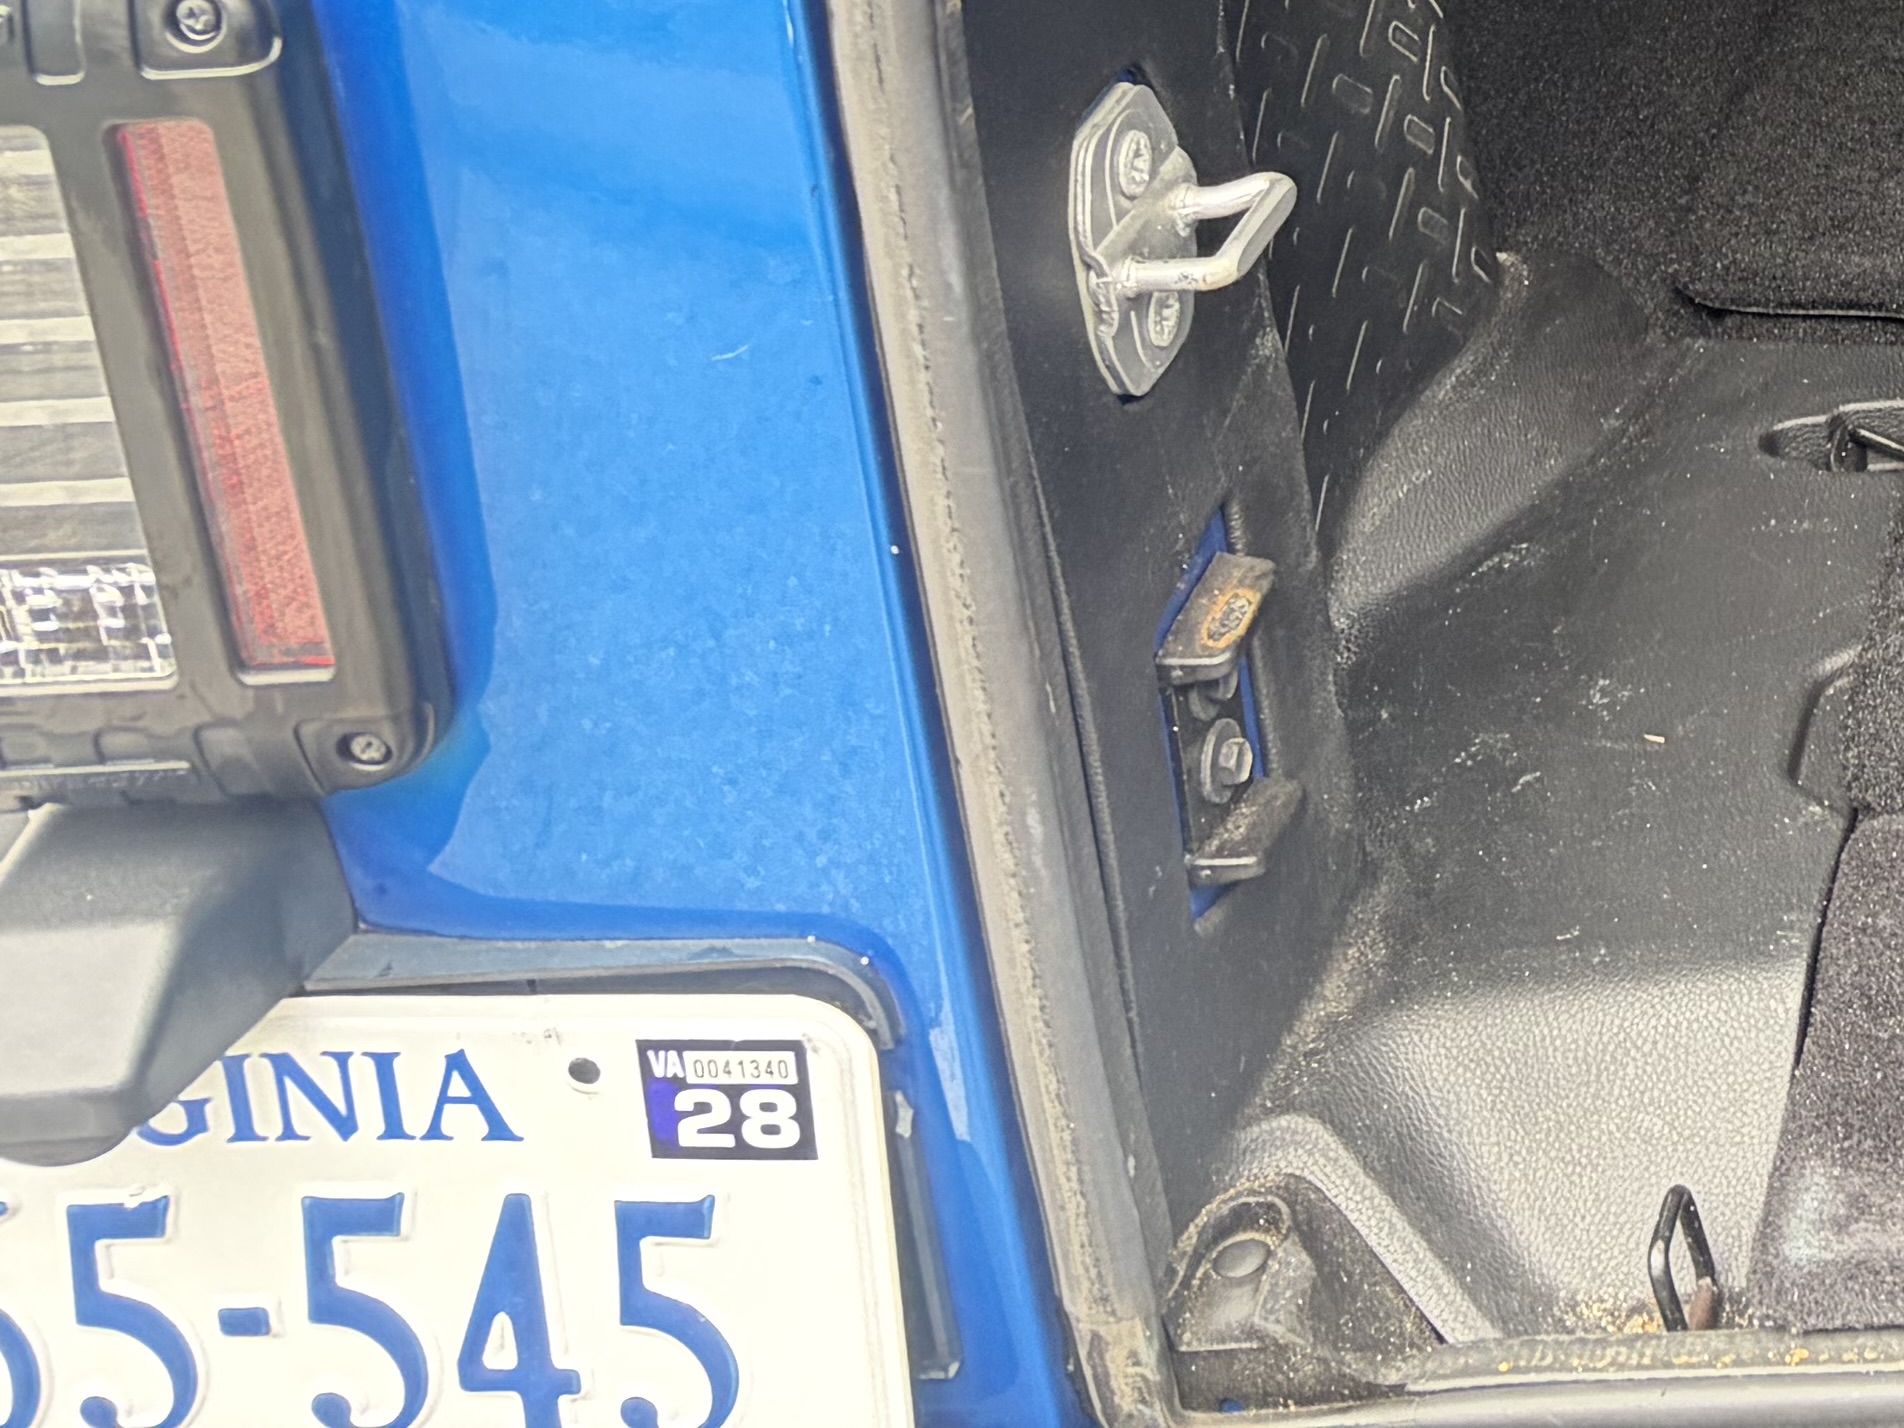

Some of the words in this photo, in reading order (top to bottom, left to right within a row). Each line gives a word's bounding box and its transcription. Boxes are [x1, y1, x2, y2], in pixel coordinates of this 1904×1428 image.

[646, 1049, 686, 1079] VA
[693, 1059, 789, 1079] 0041340
[674, 1088, 801, 1149] 28
